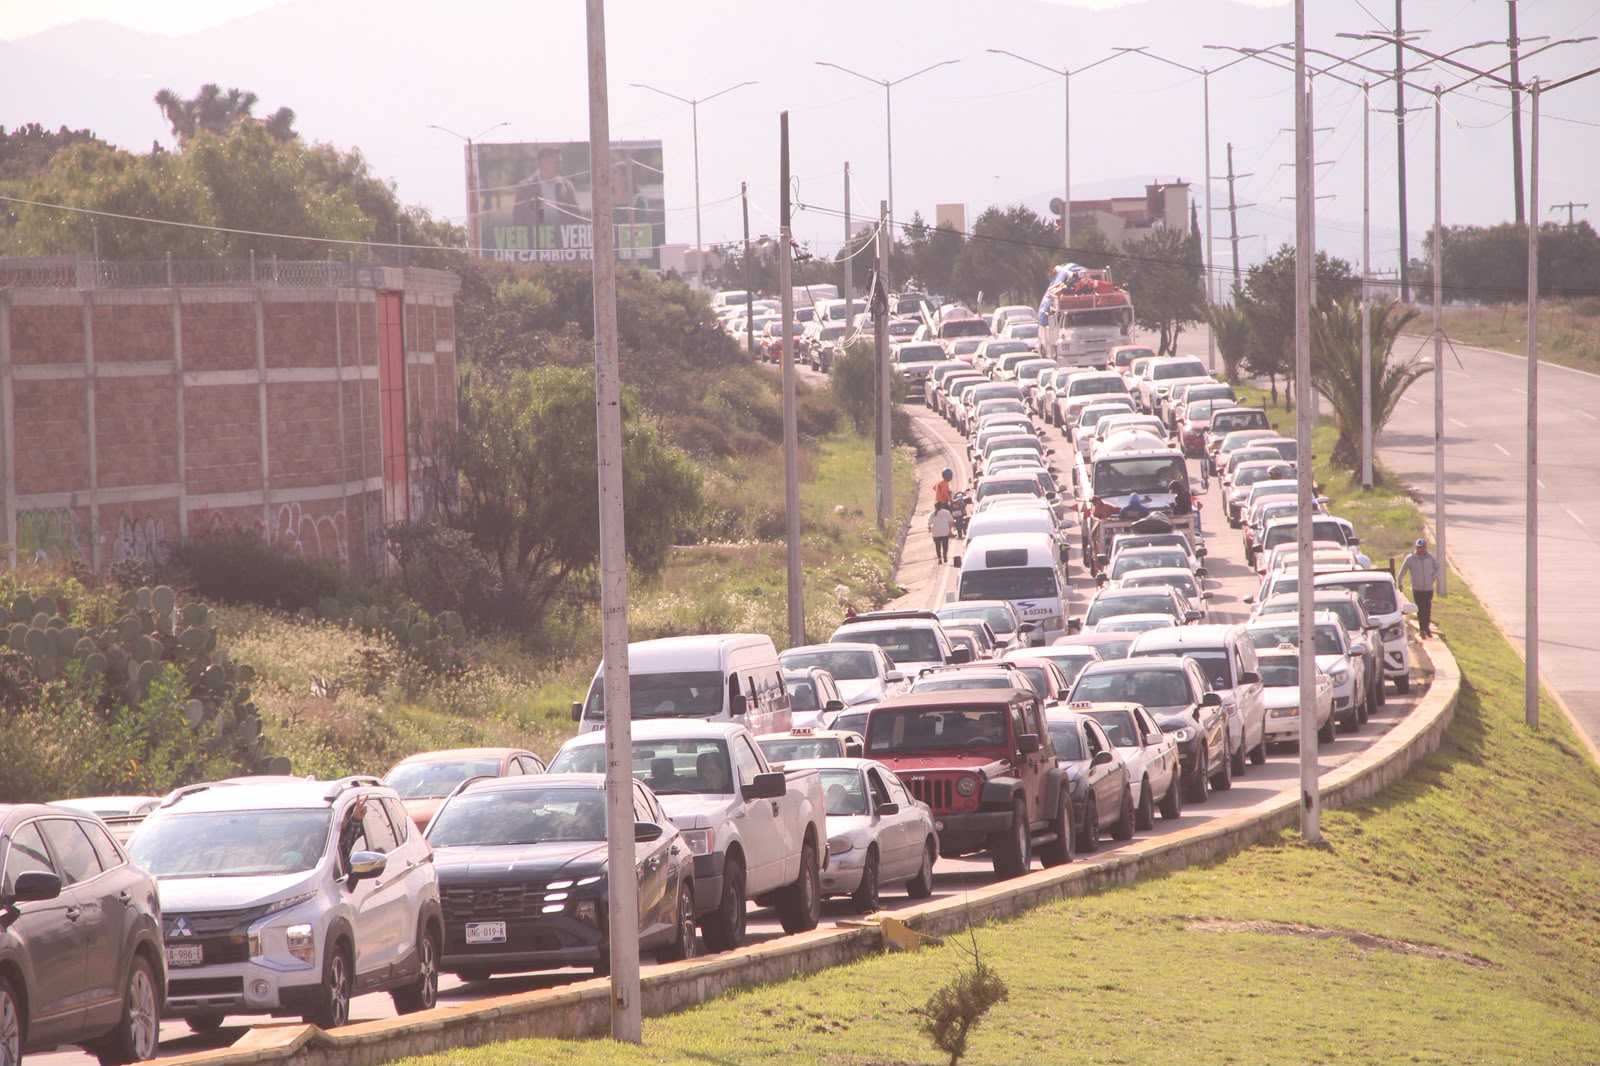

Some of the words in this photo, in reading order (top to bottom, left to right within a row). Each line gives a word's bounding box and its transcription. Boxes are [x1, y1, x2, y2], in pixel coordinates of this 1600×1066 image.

[494, 225, 528, 249] VER
[495, 250, 514, 262] UN
[518, 250, 577, 262] CAMBIO
